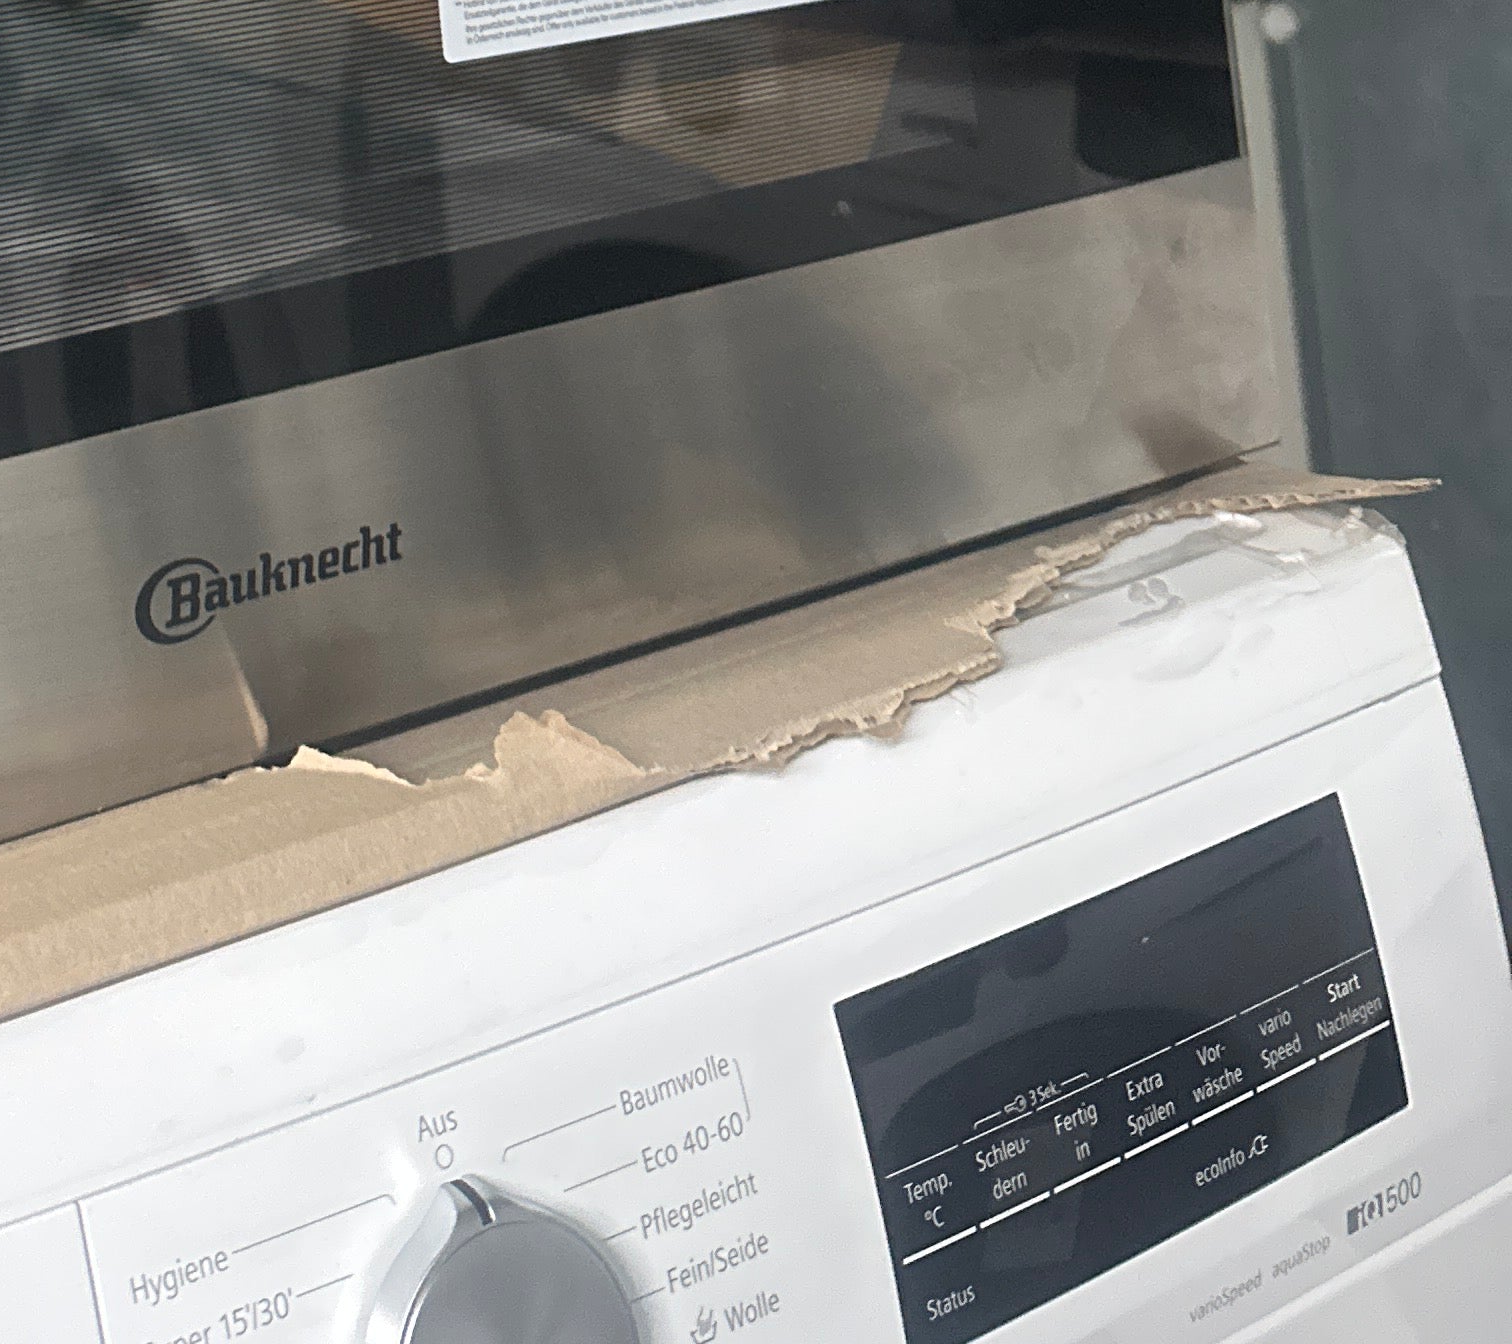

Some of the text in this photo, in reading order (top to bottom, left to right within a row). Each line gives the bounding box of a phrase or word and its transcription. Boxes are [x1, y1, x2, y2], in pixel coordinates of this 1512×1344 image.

[135, 522, 403, 645] Bauknecht
[1327, 973, 1362, 1003] Start
[1258, 1008, 1292, 1037] vario
[1316, 995, 1383, 1041] Nachlegen
[1195, 1042, 1226, 1067] Vor-
[1260, 1033, 1303, 1071] Speed
[620, 1055, 730, 1116] Baumwolle
[1125, 1071, 1164, 1102] Extra
[1192, 1065, 1243, 1104] wäsche
[416, 1110, 459, 1142] Aus
[1053, 1102, 1098, 1136] Fertig
[1127, 1100, 1176, 1137] Spülen
[642, 1111, 744, 1173] Eco 40-60
[975, 1136, 1031, 1173] Schleu-
[1074, 1140, 1091, 1162] in
[903, 1172, 953, 1204] Temp.
[992, 1172, 1028, 1200] dern
[640, 1172, 759, 1240] Pflegeleicht
[924, 1206, 945, 1228] °C
[130, 1248, 230, 1306] Hygiene
[667, 1232, 770, 1294] Fein/Seide
[1189, 1234, 1331, 1324] varioSpeed aquaStop
[723, 1291, 781, 1332] Wolle
[926, 1284, 976, 1321] Status
